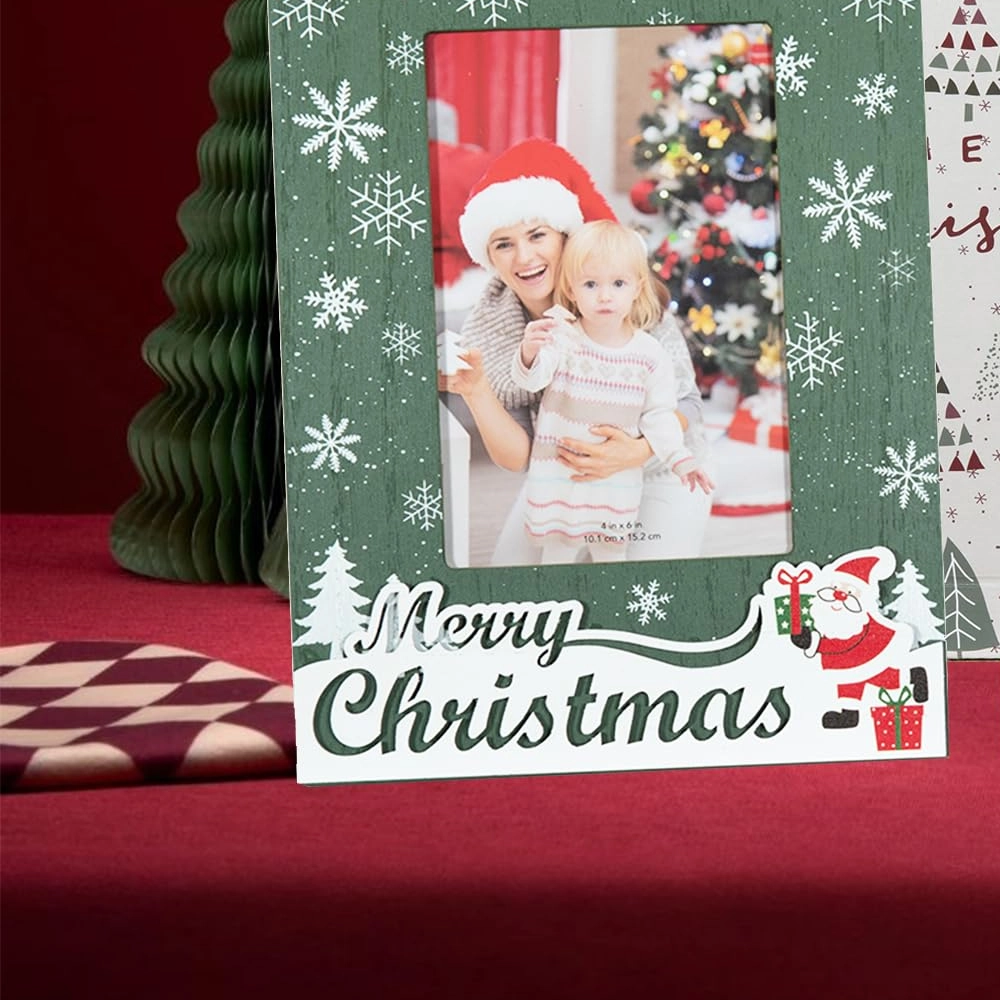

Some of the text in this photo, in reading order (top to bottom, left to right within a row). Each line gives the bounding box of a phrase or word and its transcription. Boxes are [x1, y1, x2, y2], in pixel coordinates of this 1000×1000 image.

[584, 534, 602, 543] 10.1
[628, 532, 646, 541] 15.2
[648, 533, 661, 541] cm
[608, 521, 617, 529] in
[626, 521, 632, 529] 6
[634, 521, 643, 529] in
[353, 591, 574, 668] Merry
[312, 666, 792, 755] Christmas
